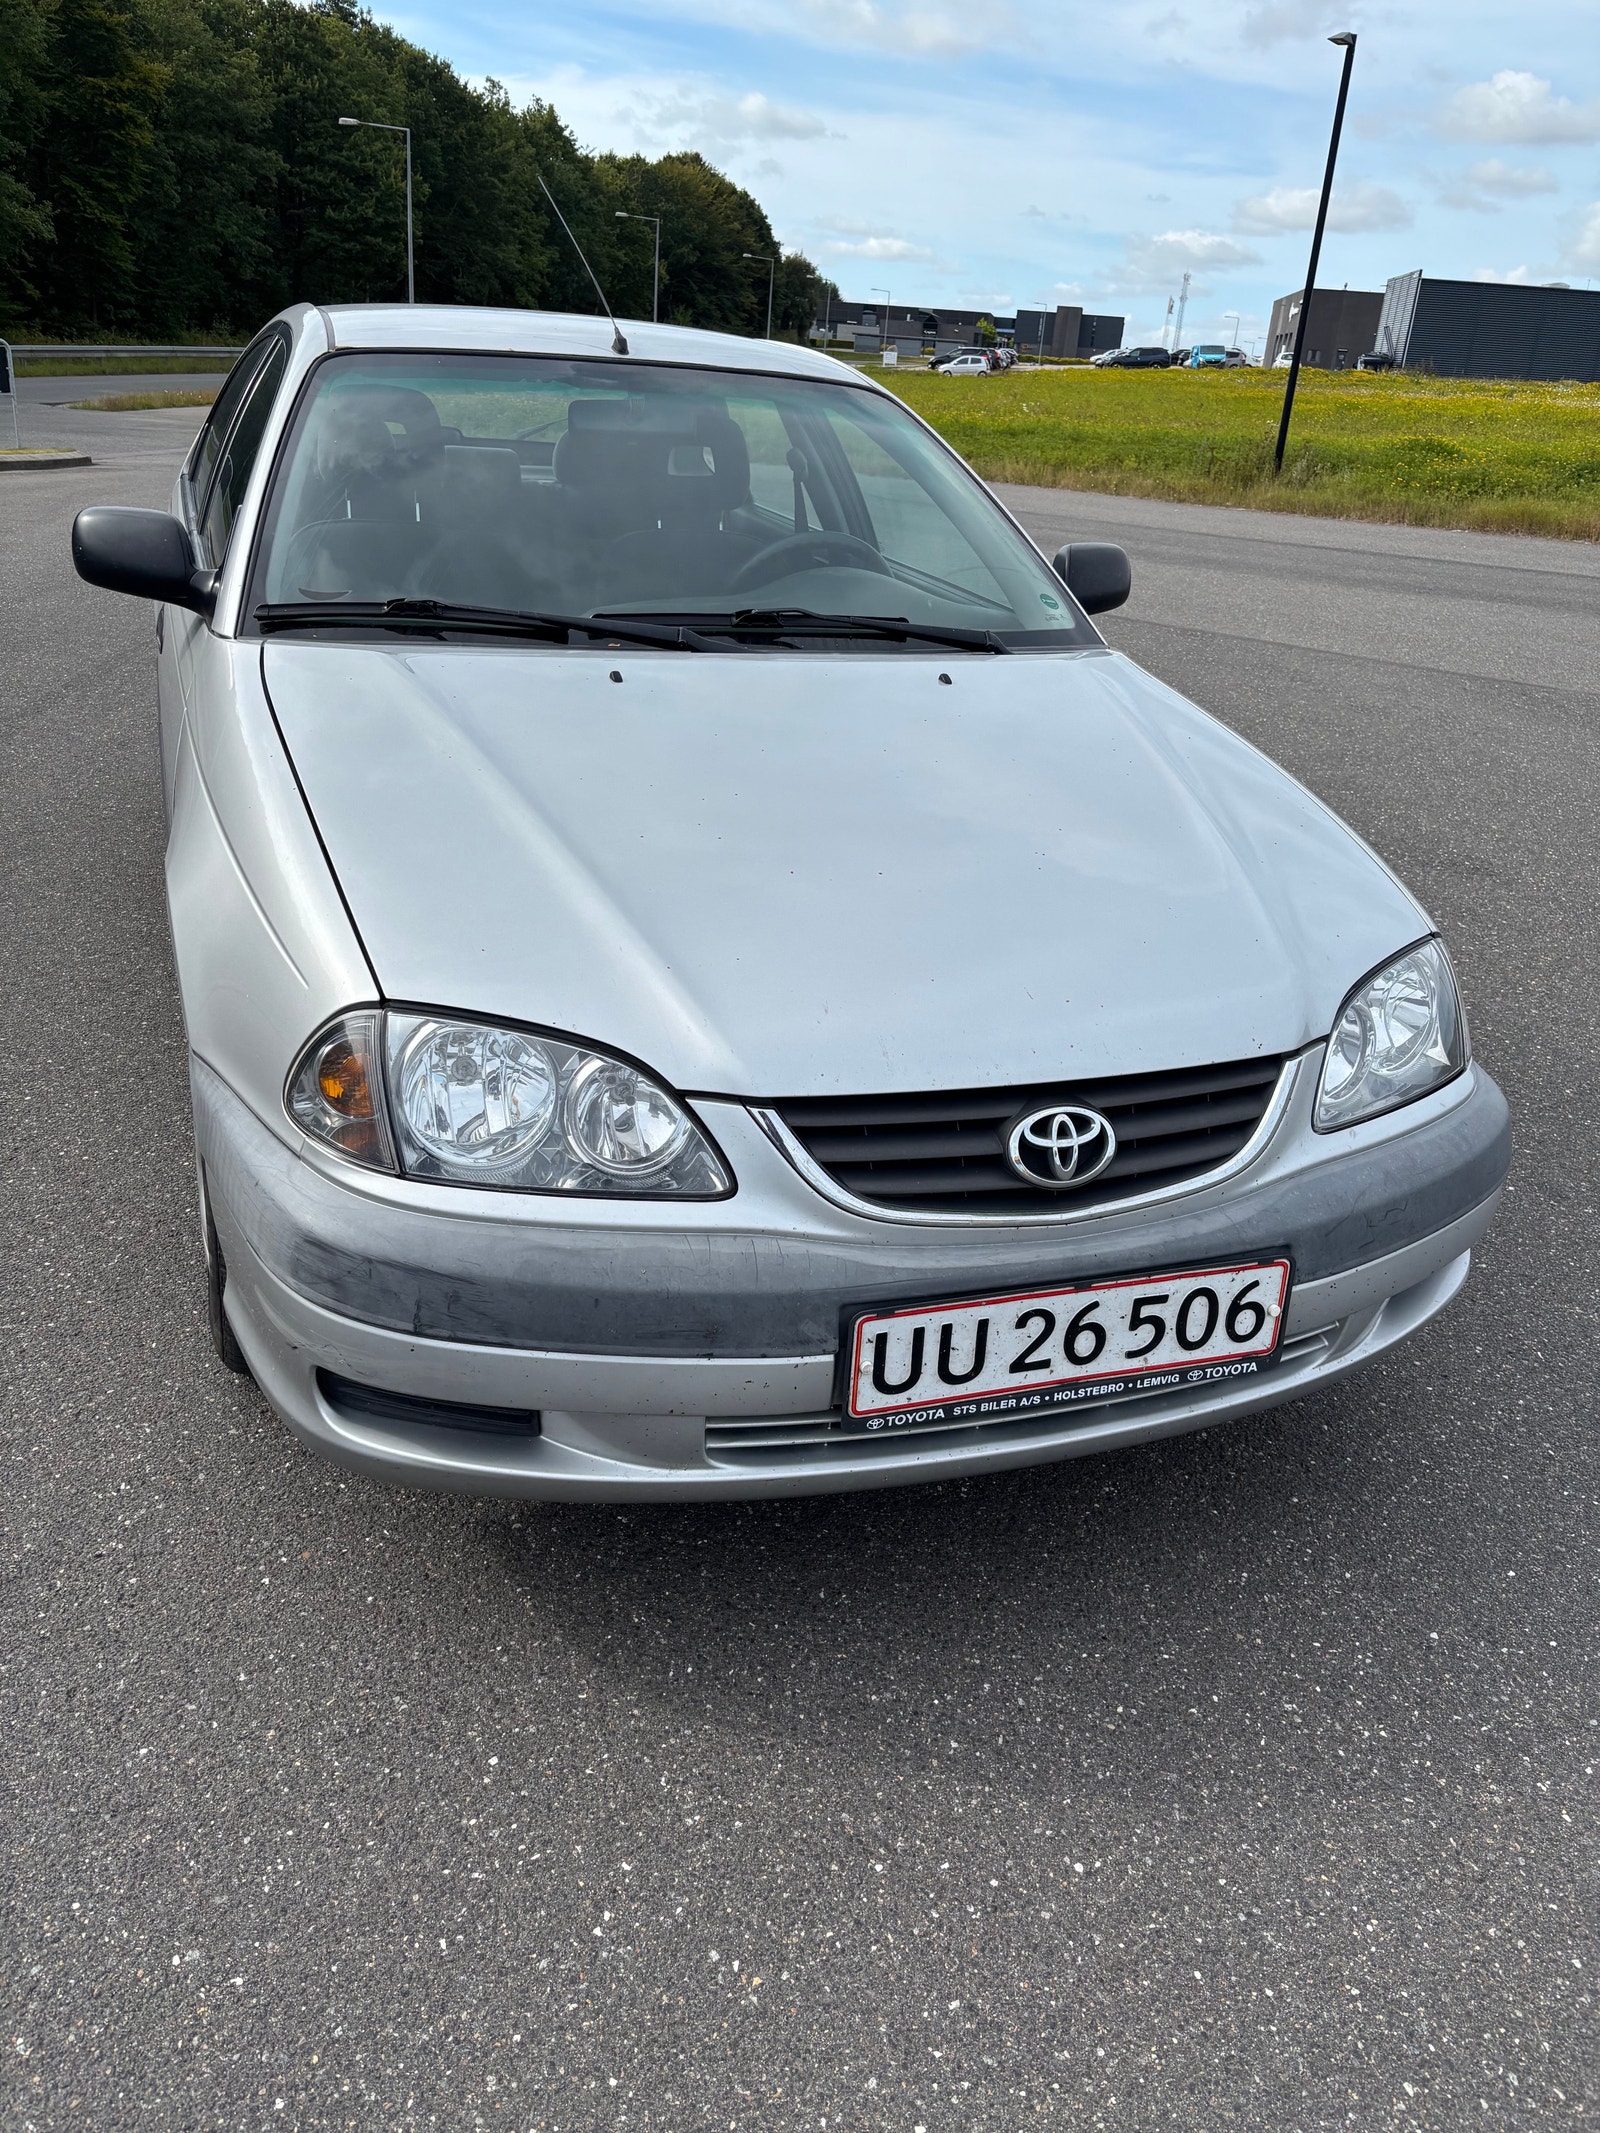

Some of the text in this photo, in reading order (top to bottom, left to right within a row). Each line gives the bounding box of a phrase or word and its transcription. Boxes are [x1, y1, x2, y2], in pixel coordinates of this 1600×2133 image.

[871, 1279, 1266, 1395] UU 26 506
[886, 1361, 1258, 1426] TOYOTA STS BILER A/S HOLSTEBRO LEMVIG TOYOTA
